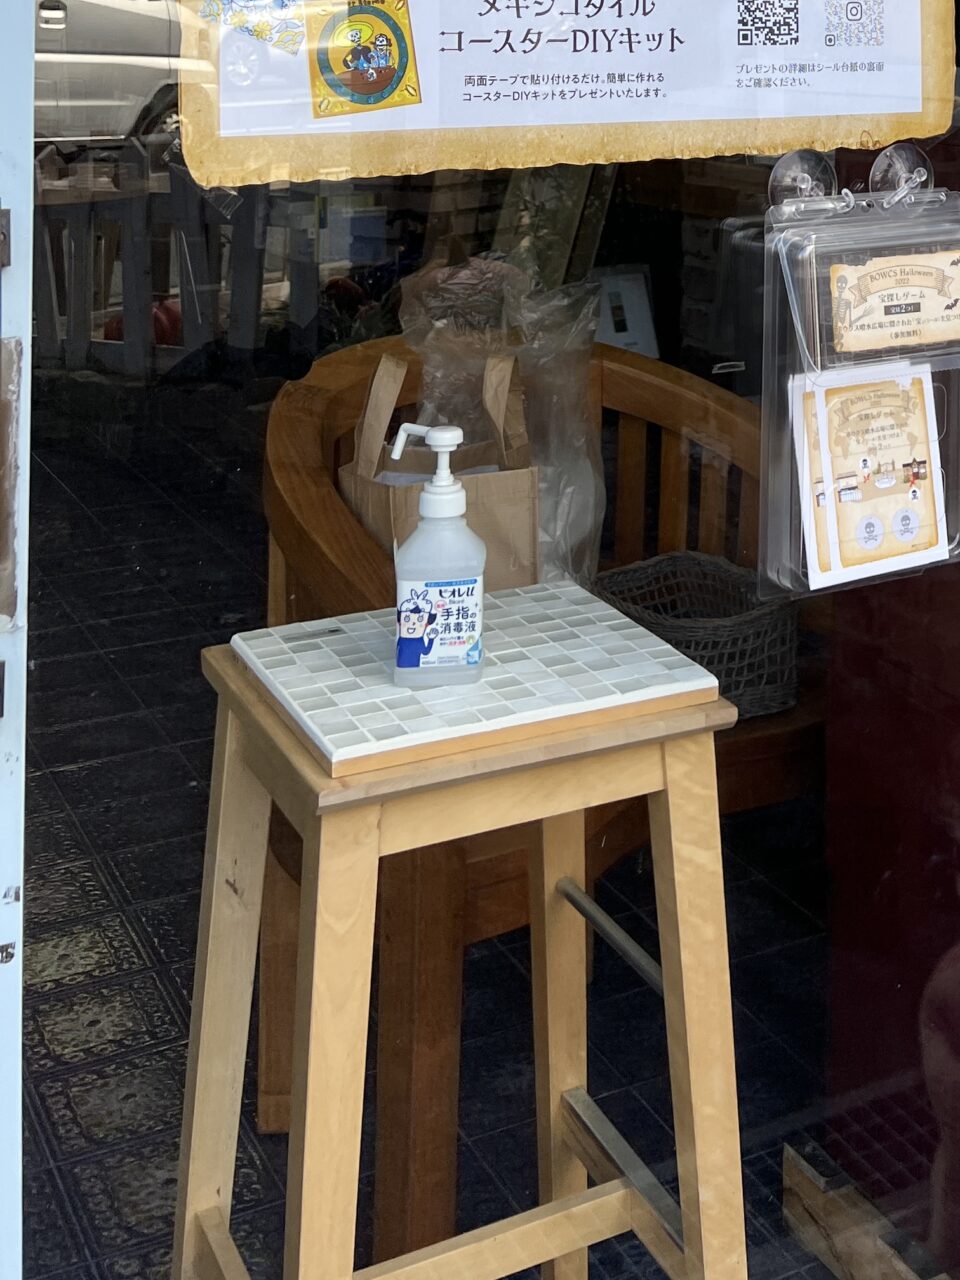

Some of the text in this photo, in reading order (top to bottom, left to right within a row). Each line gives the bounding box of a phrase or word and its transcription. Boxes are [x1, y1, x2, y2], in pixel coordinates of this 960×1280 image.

[439, 27, 686, 54] コースターDIYキット
[735, 77, 811, 89] をご確認ください。
[462, 88, 667, 103] コースターDIYキットをプレゼントいたします。
[869, 270, 898, 283] BOWCS
[441, 606, 477, 621] 手指の
[440, 620, 477, 634] 消毒液
